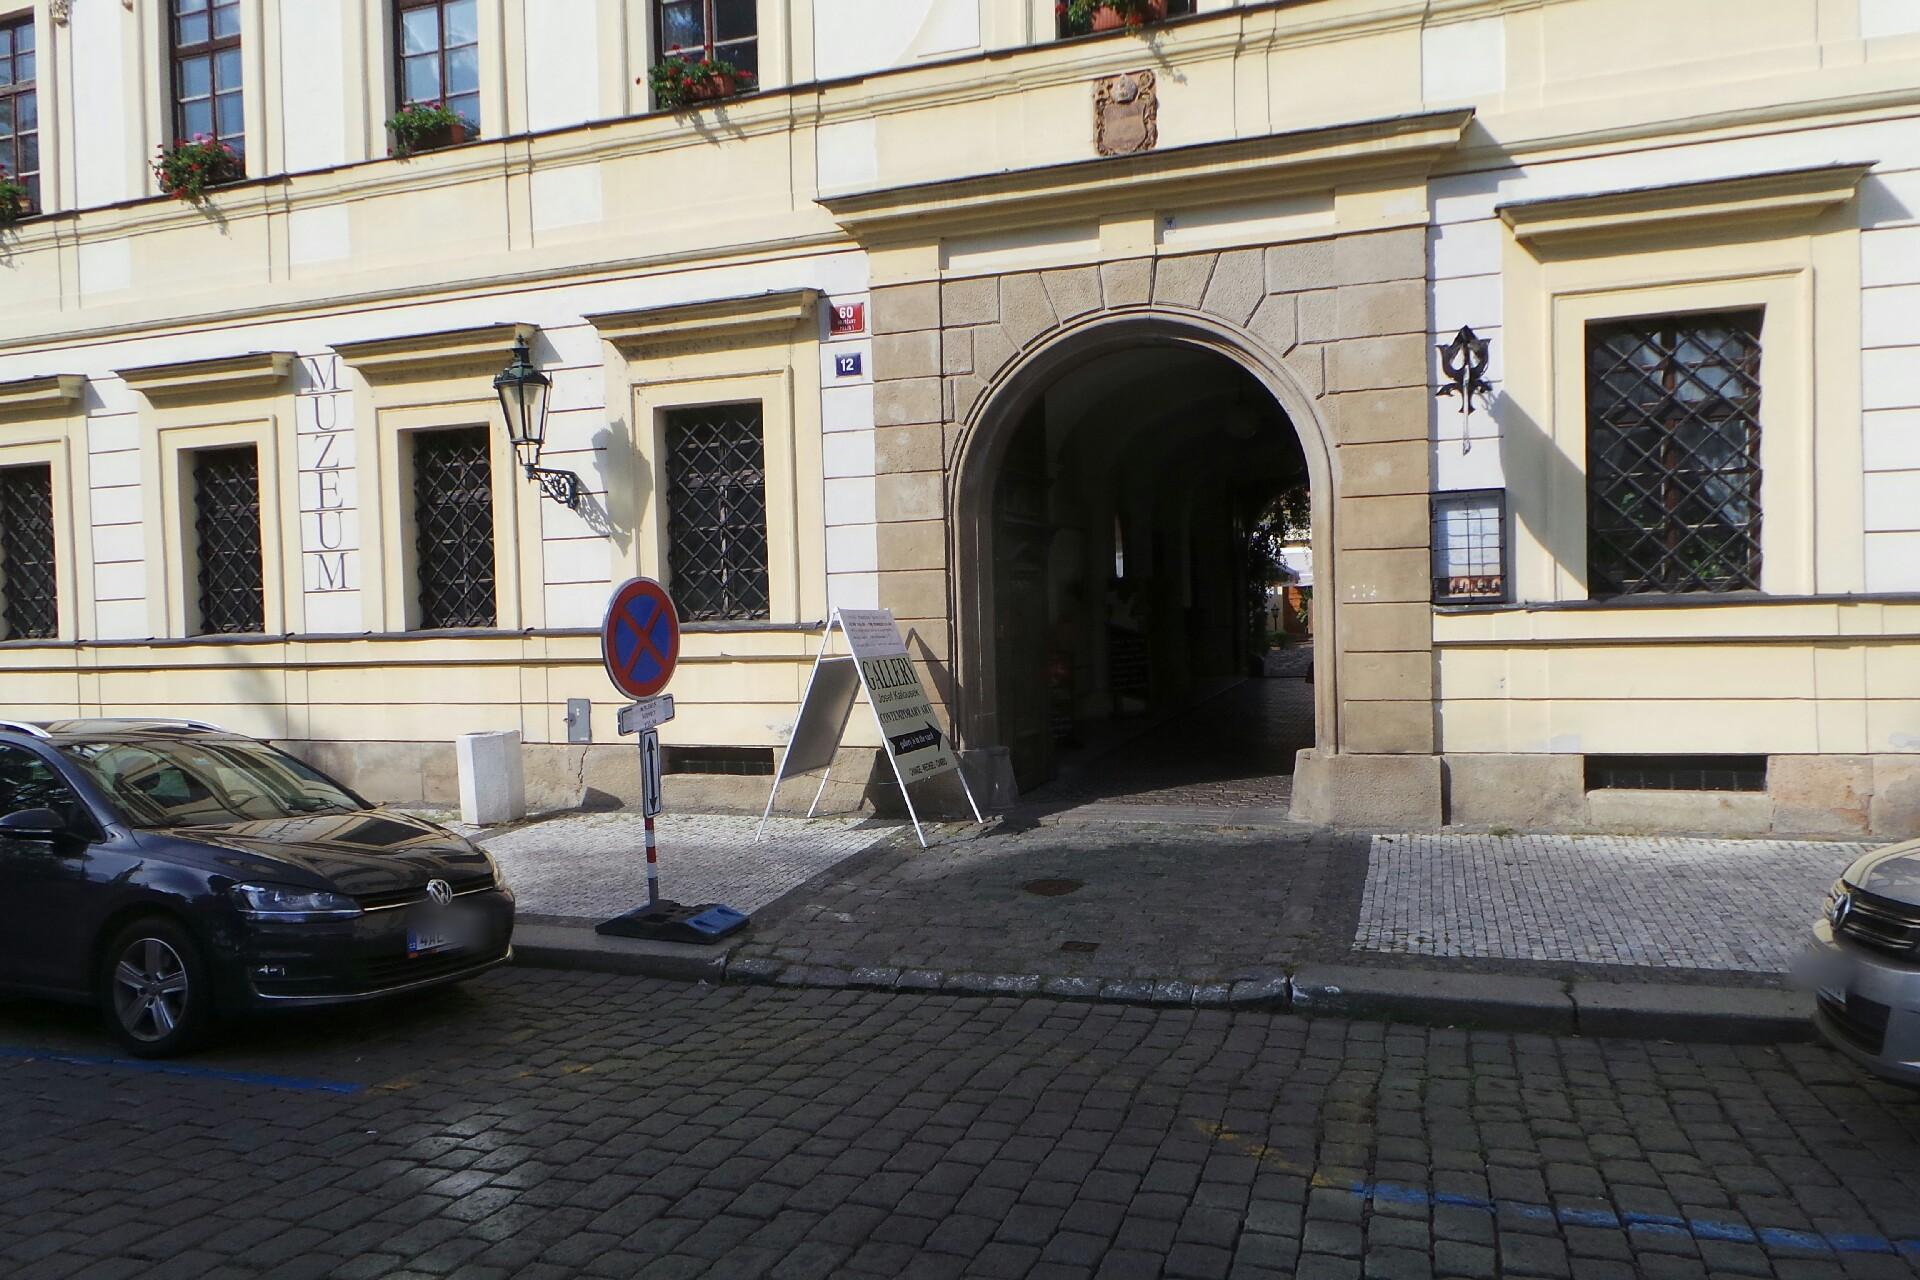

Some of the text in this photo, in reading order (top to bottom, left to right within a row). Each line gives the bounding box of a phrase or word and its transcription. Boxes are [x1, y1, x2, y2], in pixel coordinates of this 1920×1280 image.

[839, 307, 854, 319] 60
[840, 358, 854, 372] 12
[308, 354, 349, 591] MUZEUM
[862, 656, 919, 690] GALLERY
[879, 702, 932, 724] CONTEMPORARY ART
